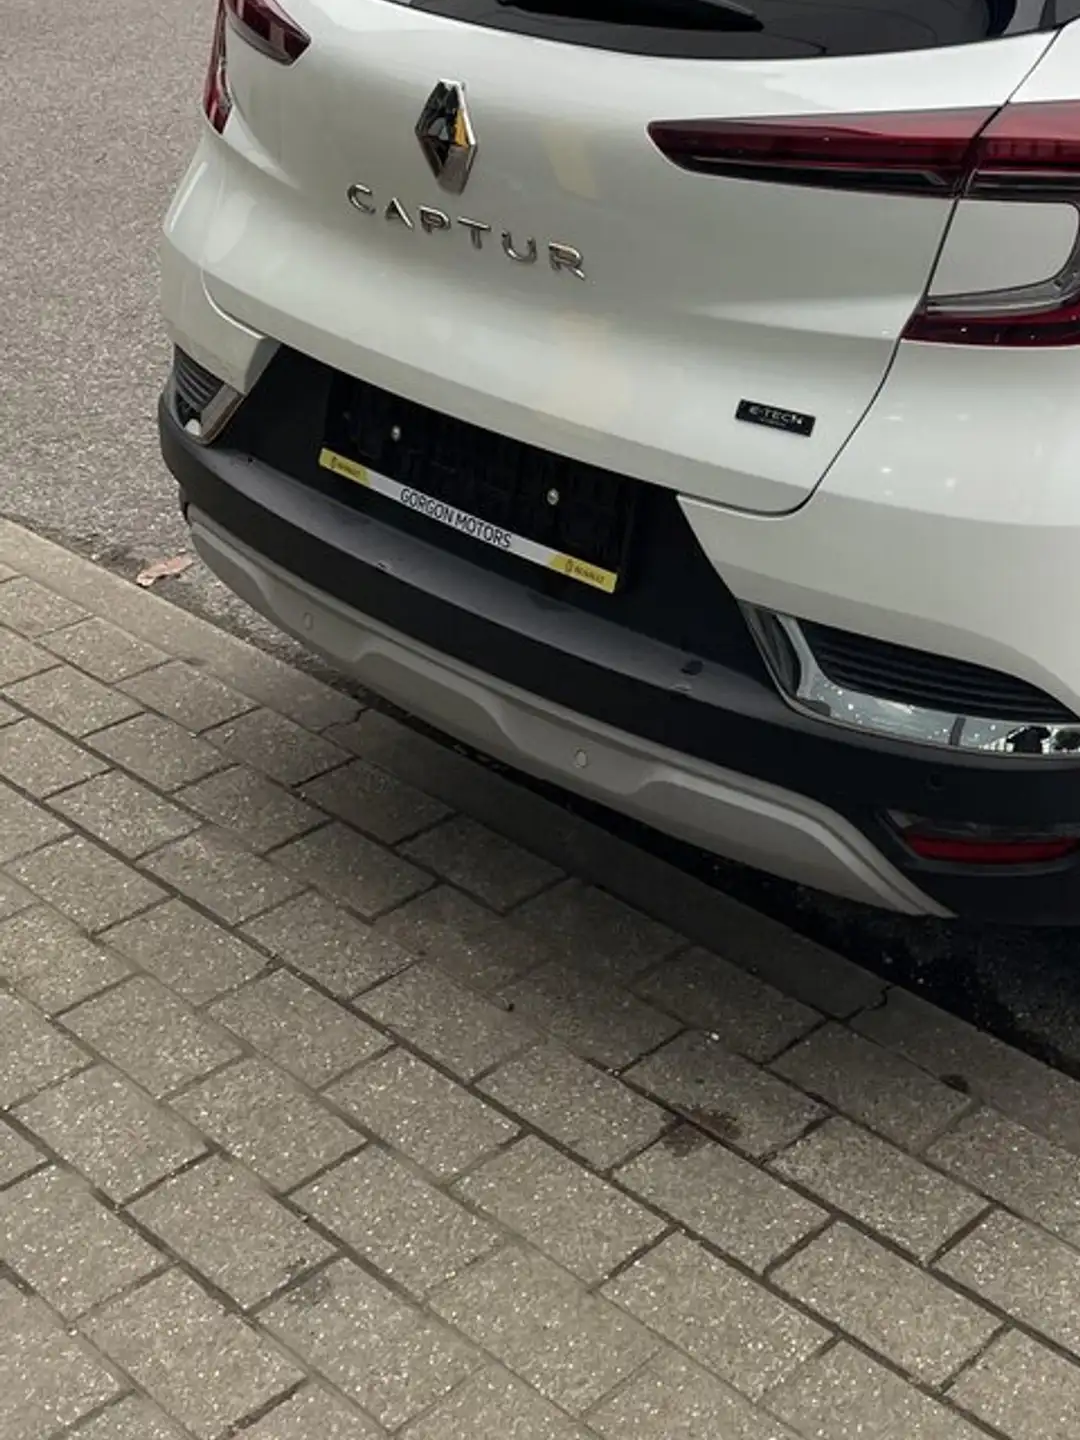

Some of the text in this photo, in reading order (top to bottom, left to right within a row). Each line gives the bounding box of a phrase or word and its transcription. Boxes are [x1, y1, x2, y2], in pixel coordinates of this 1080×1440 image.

[346, 182, 587, 282] CAPTUR
[400, 488, 512, 548] GORGON MOTORS
